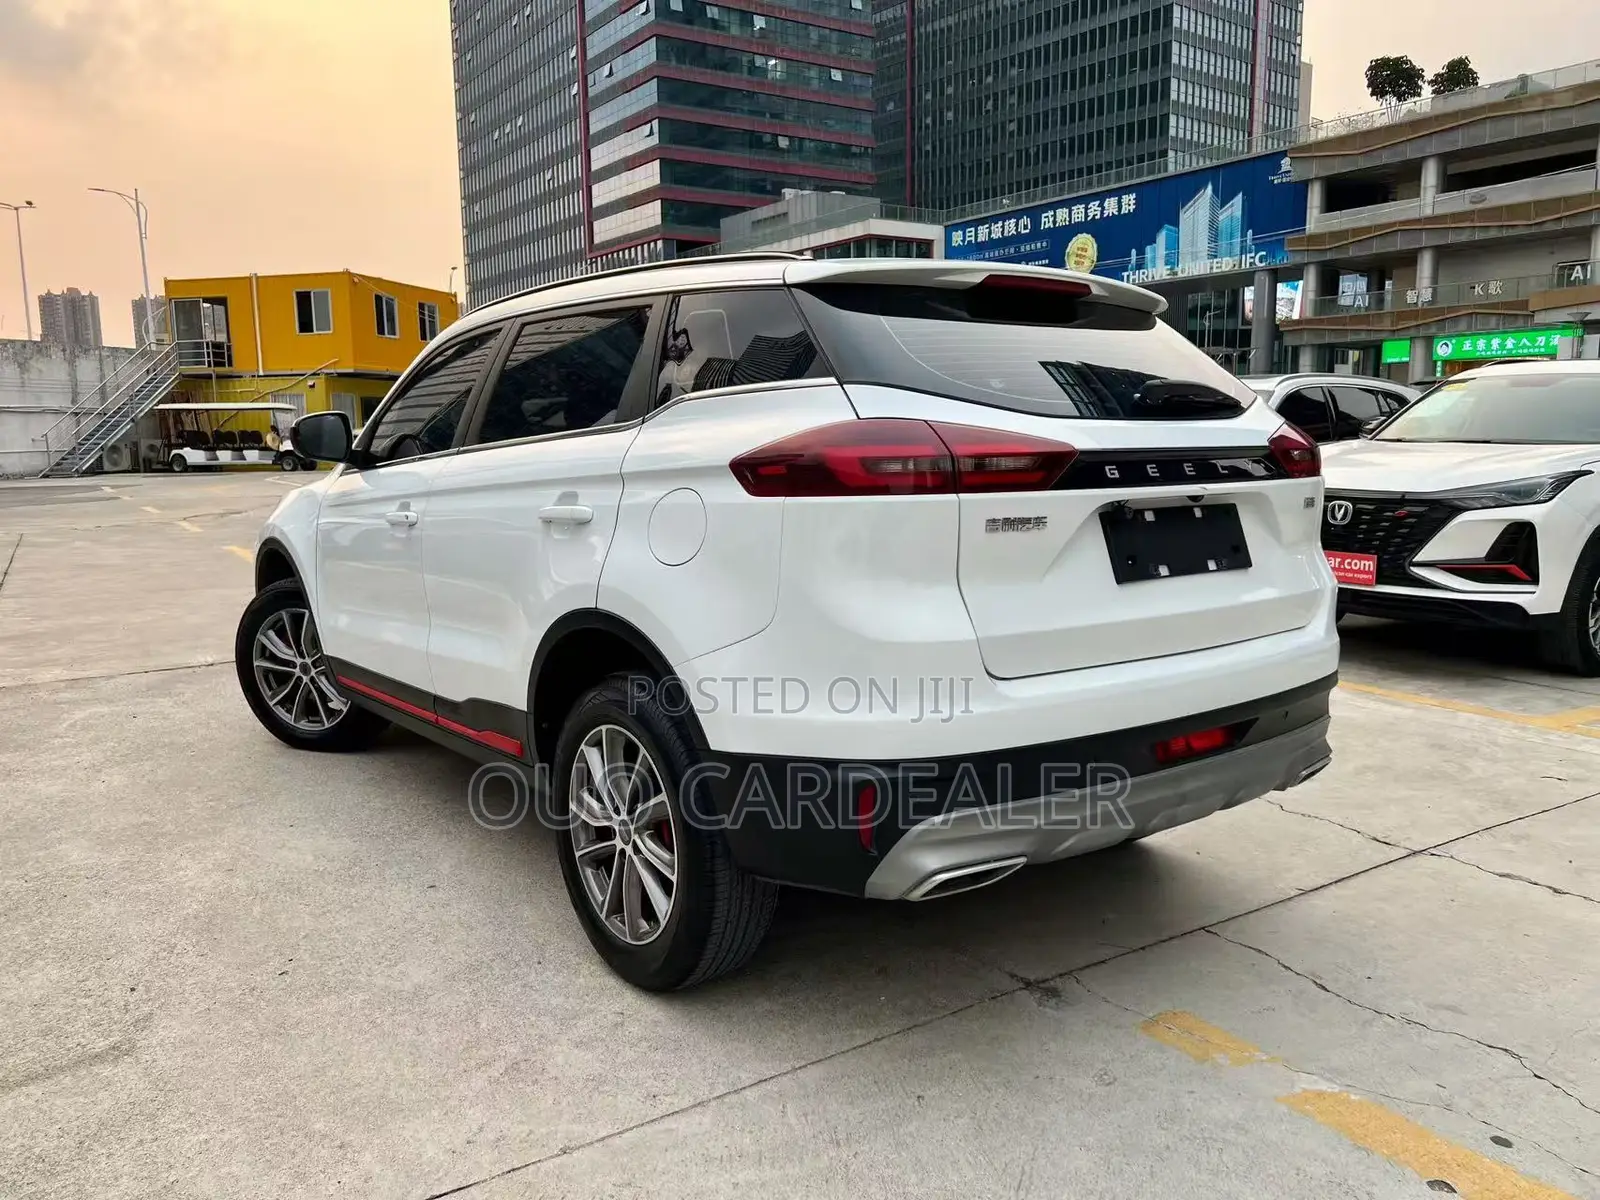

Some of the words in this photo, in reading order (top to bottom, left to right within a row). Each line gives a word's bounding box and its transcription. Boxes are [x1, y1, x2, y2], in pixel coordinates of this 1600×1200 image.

[951, 215, 1032, 247] 映月新城核心
[1040, 193, 1137, 230] 成熟商务集群
[1241, 251, 1267, 269] IFC
